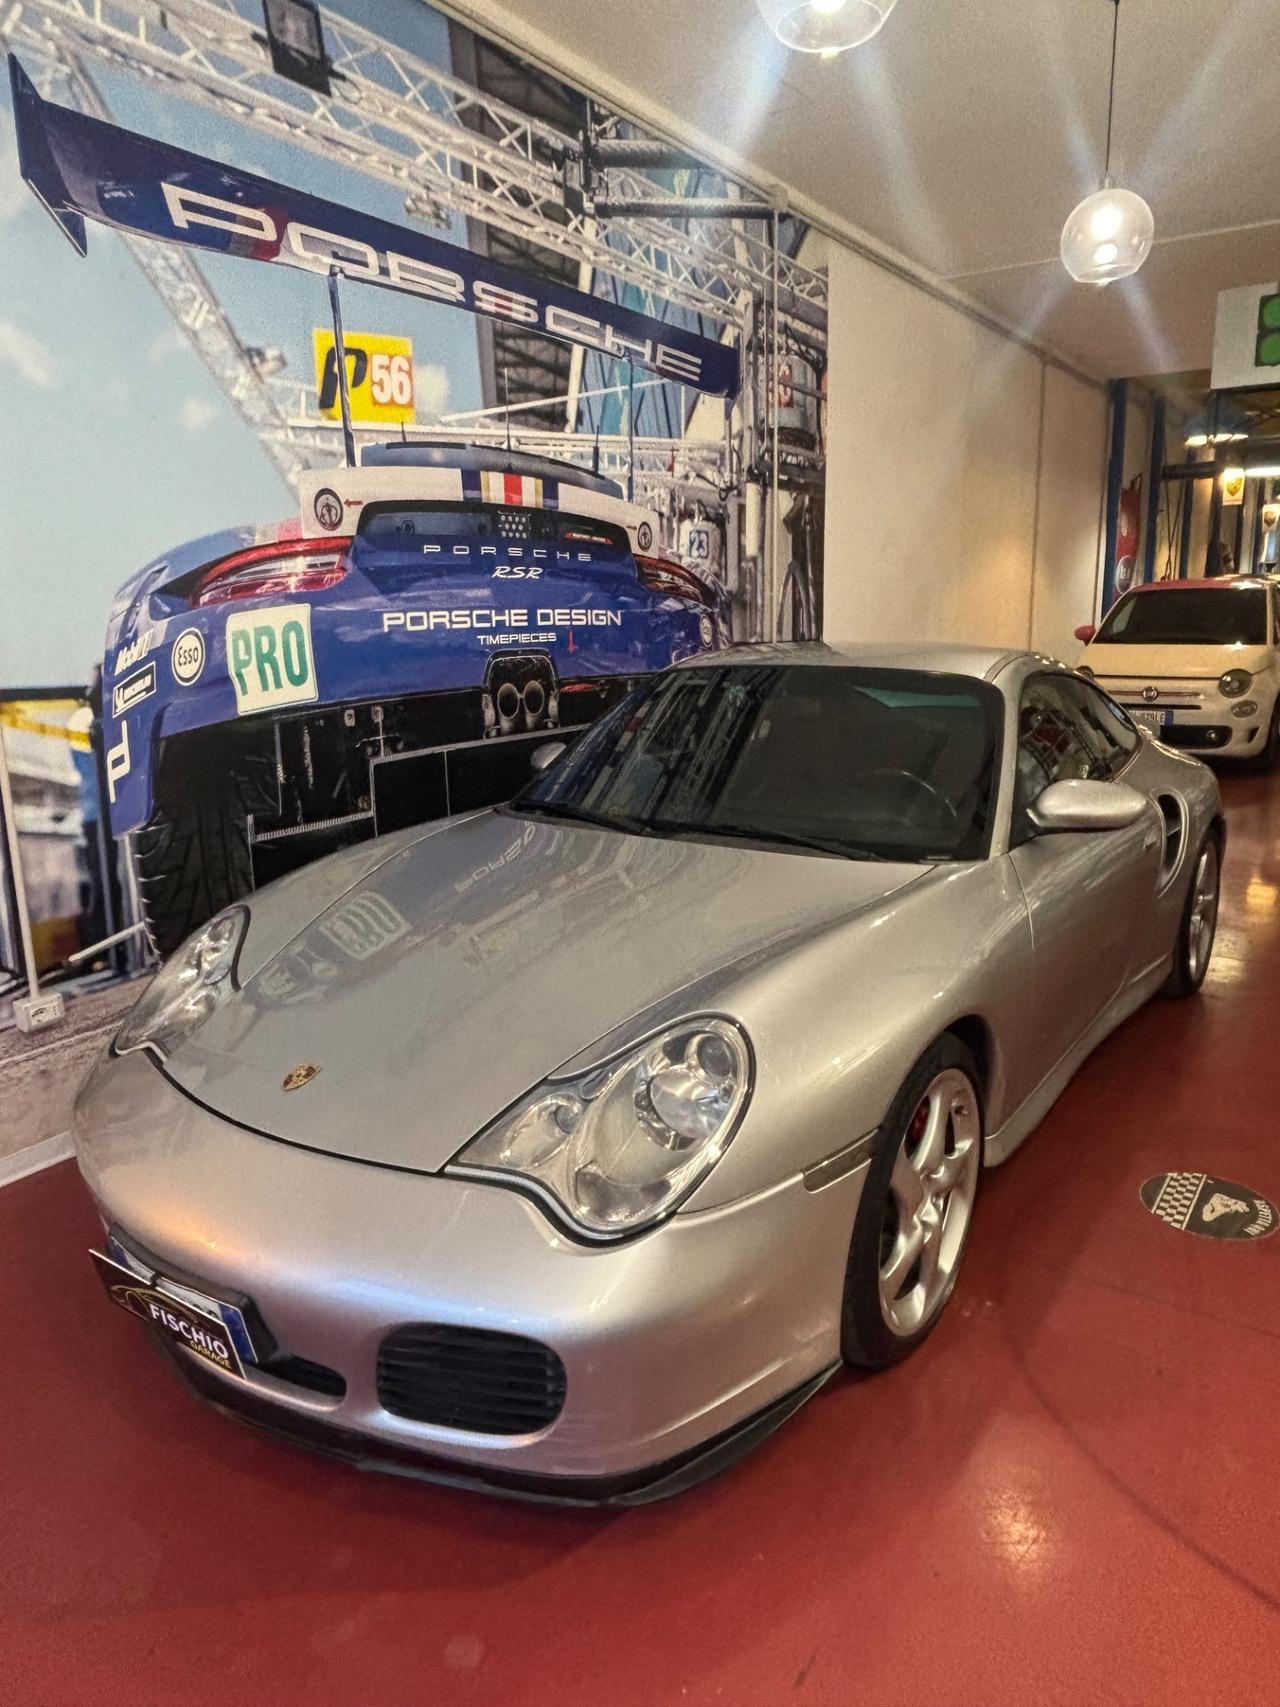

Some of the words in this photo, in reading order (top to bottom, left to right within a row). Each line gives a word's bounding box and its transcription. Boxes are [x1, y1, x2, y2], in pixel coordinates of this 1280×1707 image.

[160, 181, 702, 382] PORSCHE
[371, 354, 412, 405] 56
[423, 544, 592, 562] PORSCHE
[492, 566, 543, 580] RSR
[383, 609, 529, 633] PORSCHE
[537, 608, 623, 627] DESIGN
[477, 632, 557, 646] TIMEPIECES
[231, 619, 309, 697] PRO
[150, 1303, 229, 1359] FISCHIO
